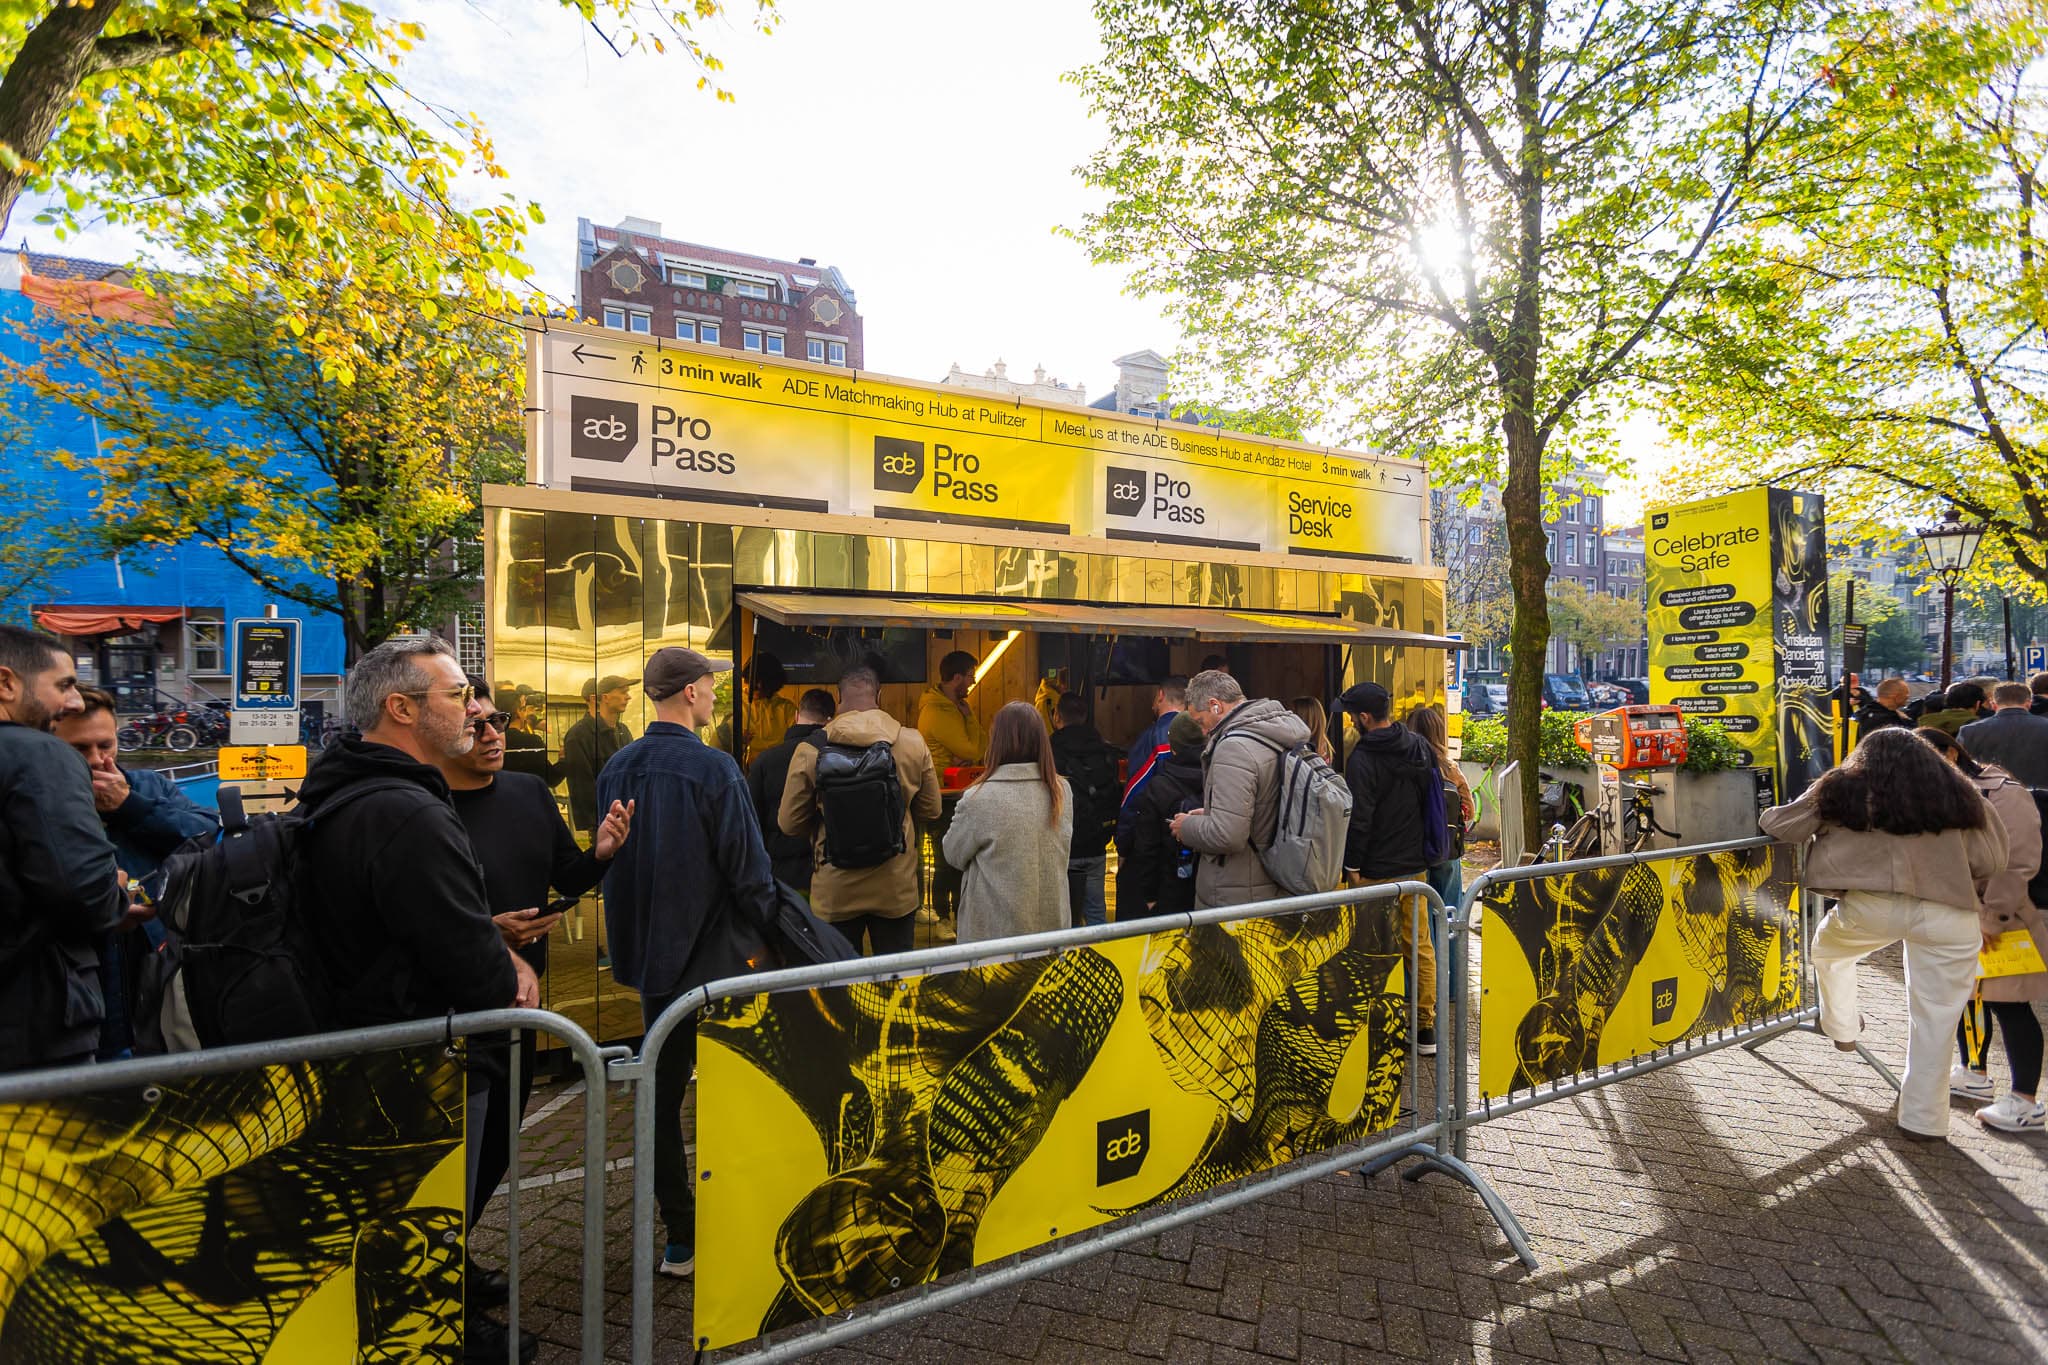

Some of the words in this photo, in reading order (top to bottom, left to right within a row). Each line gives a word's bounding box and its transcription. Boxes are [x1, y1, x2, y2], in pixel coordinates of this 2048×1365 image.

[661, 358, 674, 375] 3
[679, 364, 714, 382] min
[720, 372, 762, 389] walk
[782, 378, 819, 397] ADE
[824, 384, 924, 416] Matchmaking
[929, 400, 958, 418] Hub
[962, 407, 975, 421] at
[979, 408, 1027, 427] Pulitzer
[583, 415, 627, 443] ade
[652, 405, 711, 441] Pro
[651, 437, 736, 475] Pass
[1054, 419, 1086, 437] Meet
[1089, 428, 1104, 439] us
[1107, 430, 1118, 441] at
[1122, 431, 1140, 445] the
[1142, 433, 1168, 448] ADE
[1170, 437, 1218, 457] Business
[1220, 446, 1241, 461] Hub
[1243, 453, 1253, 463] at
[1254, 454, 1285, 468] Andaz
[1288, 458, 1312, 471] Hotel
[882, 452, 916, 476] ade
[934, 443, 980, 473] Pro
[1322, 462, 1329, 474] 3
[1330, 464, 1348, 476] min
[1350, 467, 1371, 480] walk
[933, 471, 998, 503] Pass
[1113, 480, 1140, 500] ade
[1154, 471, 1191, 499] Pro
[1153, 497, 1205, 524] Pass
[1288, 491, 1352, 518] Service
[1289, 514, 1334, 538] Desk
[1653, 526, 1759, 557] Celebrate
[1680, 551, 1730, 573] Safe
[1699, 618, 1721, 626] without
[1704, 612, 1722, 620] drugs
[1711, 606, 1732, 614] alcohol
[1686, 635, 1697, 643] my
[1783, 633, 1823, 646] Amsterdam
[1782, 648, 1804, 660] Dance
[1805, 648, 1825, 660] Event
[1782, 675, 1809, 688] October
[1810, 675, 1827, 688] 2024
[1677, 699, 1693, 707] Enjoy
[1657, 988, 1673, 1009] ade
[1106, 1128, 1142, 1161] ade
